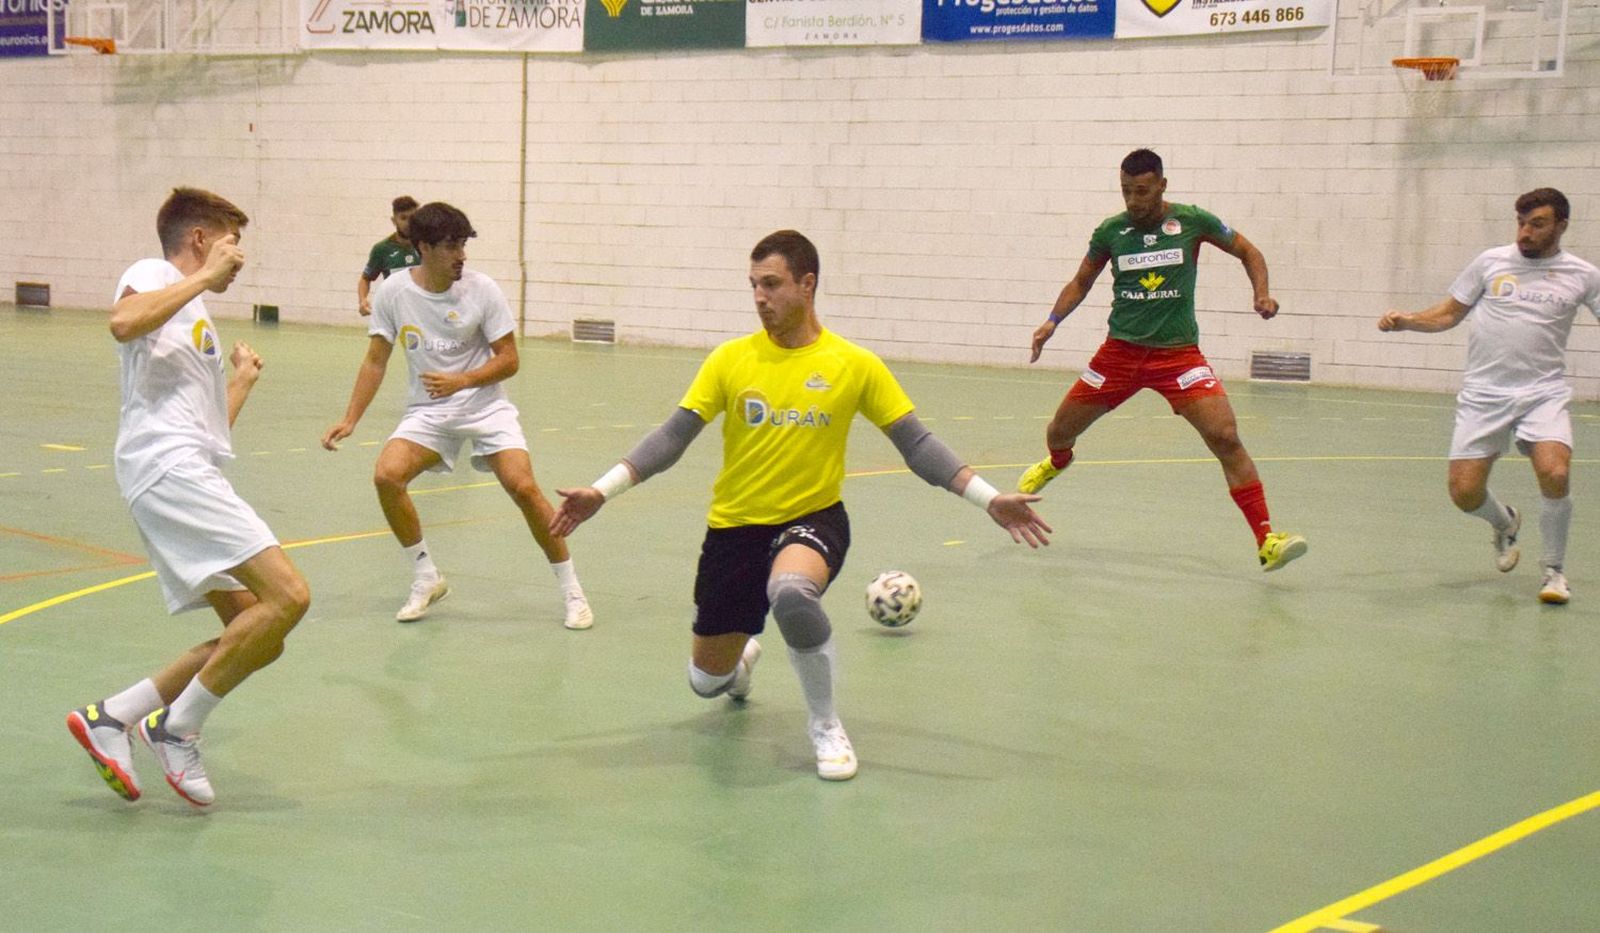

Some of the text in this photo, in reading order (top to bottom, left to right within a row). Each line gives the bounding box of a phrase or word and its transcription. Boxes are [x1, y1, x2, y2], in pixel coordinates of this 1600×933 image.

[640, 4, 694, 16] DE ZAMORA
[1067, 4, 1076, 14] de
[1077, 4, 1099, 13] datos
[342, 11, 436, 34] ZAMORA
[469, 6, 581, 28] DE ZAMORA
[897, 14, 905, 26] 5
[1209, 6, 1305, 27] 673 446 866
[969, 22, 1065, 35] www.progesdatos.com
[1127, 250, 1181, 266] euronics
[1121, 289, 1181, 300] CAJA RURAL
